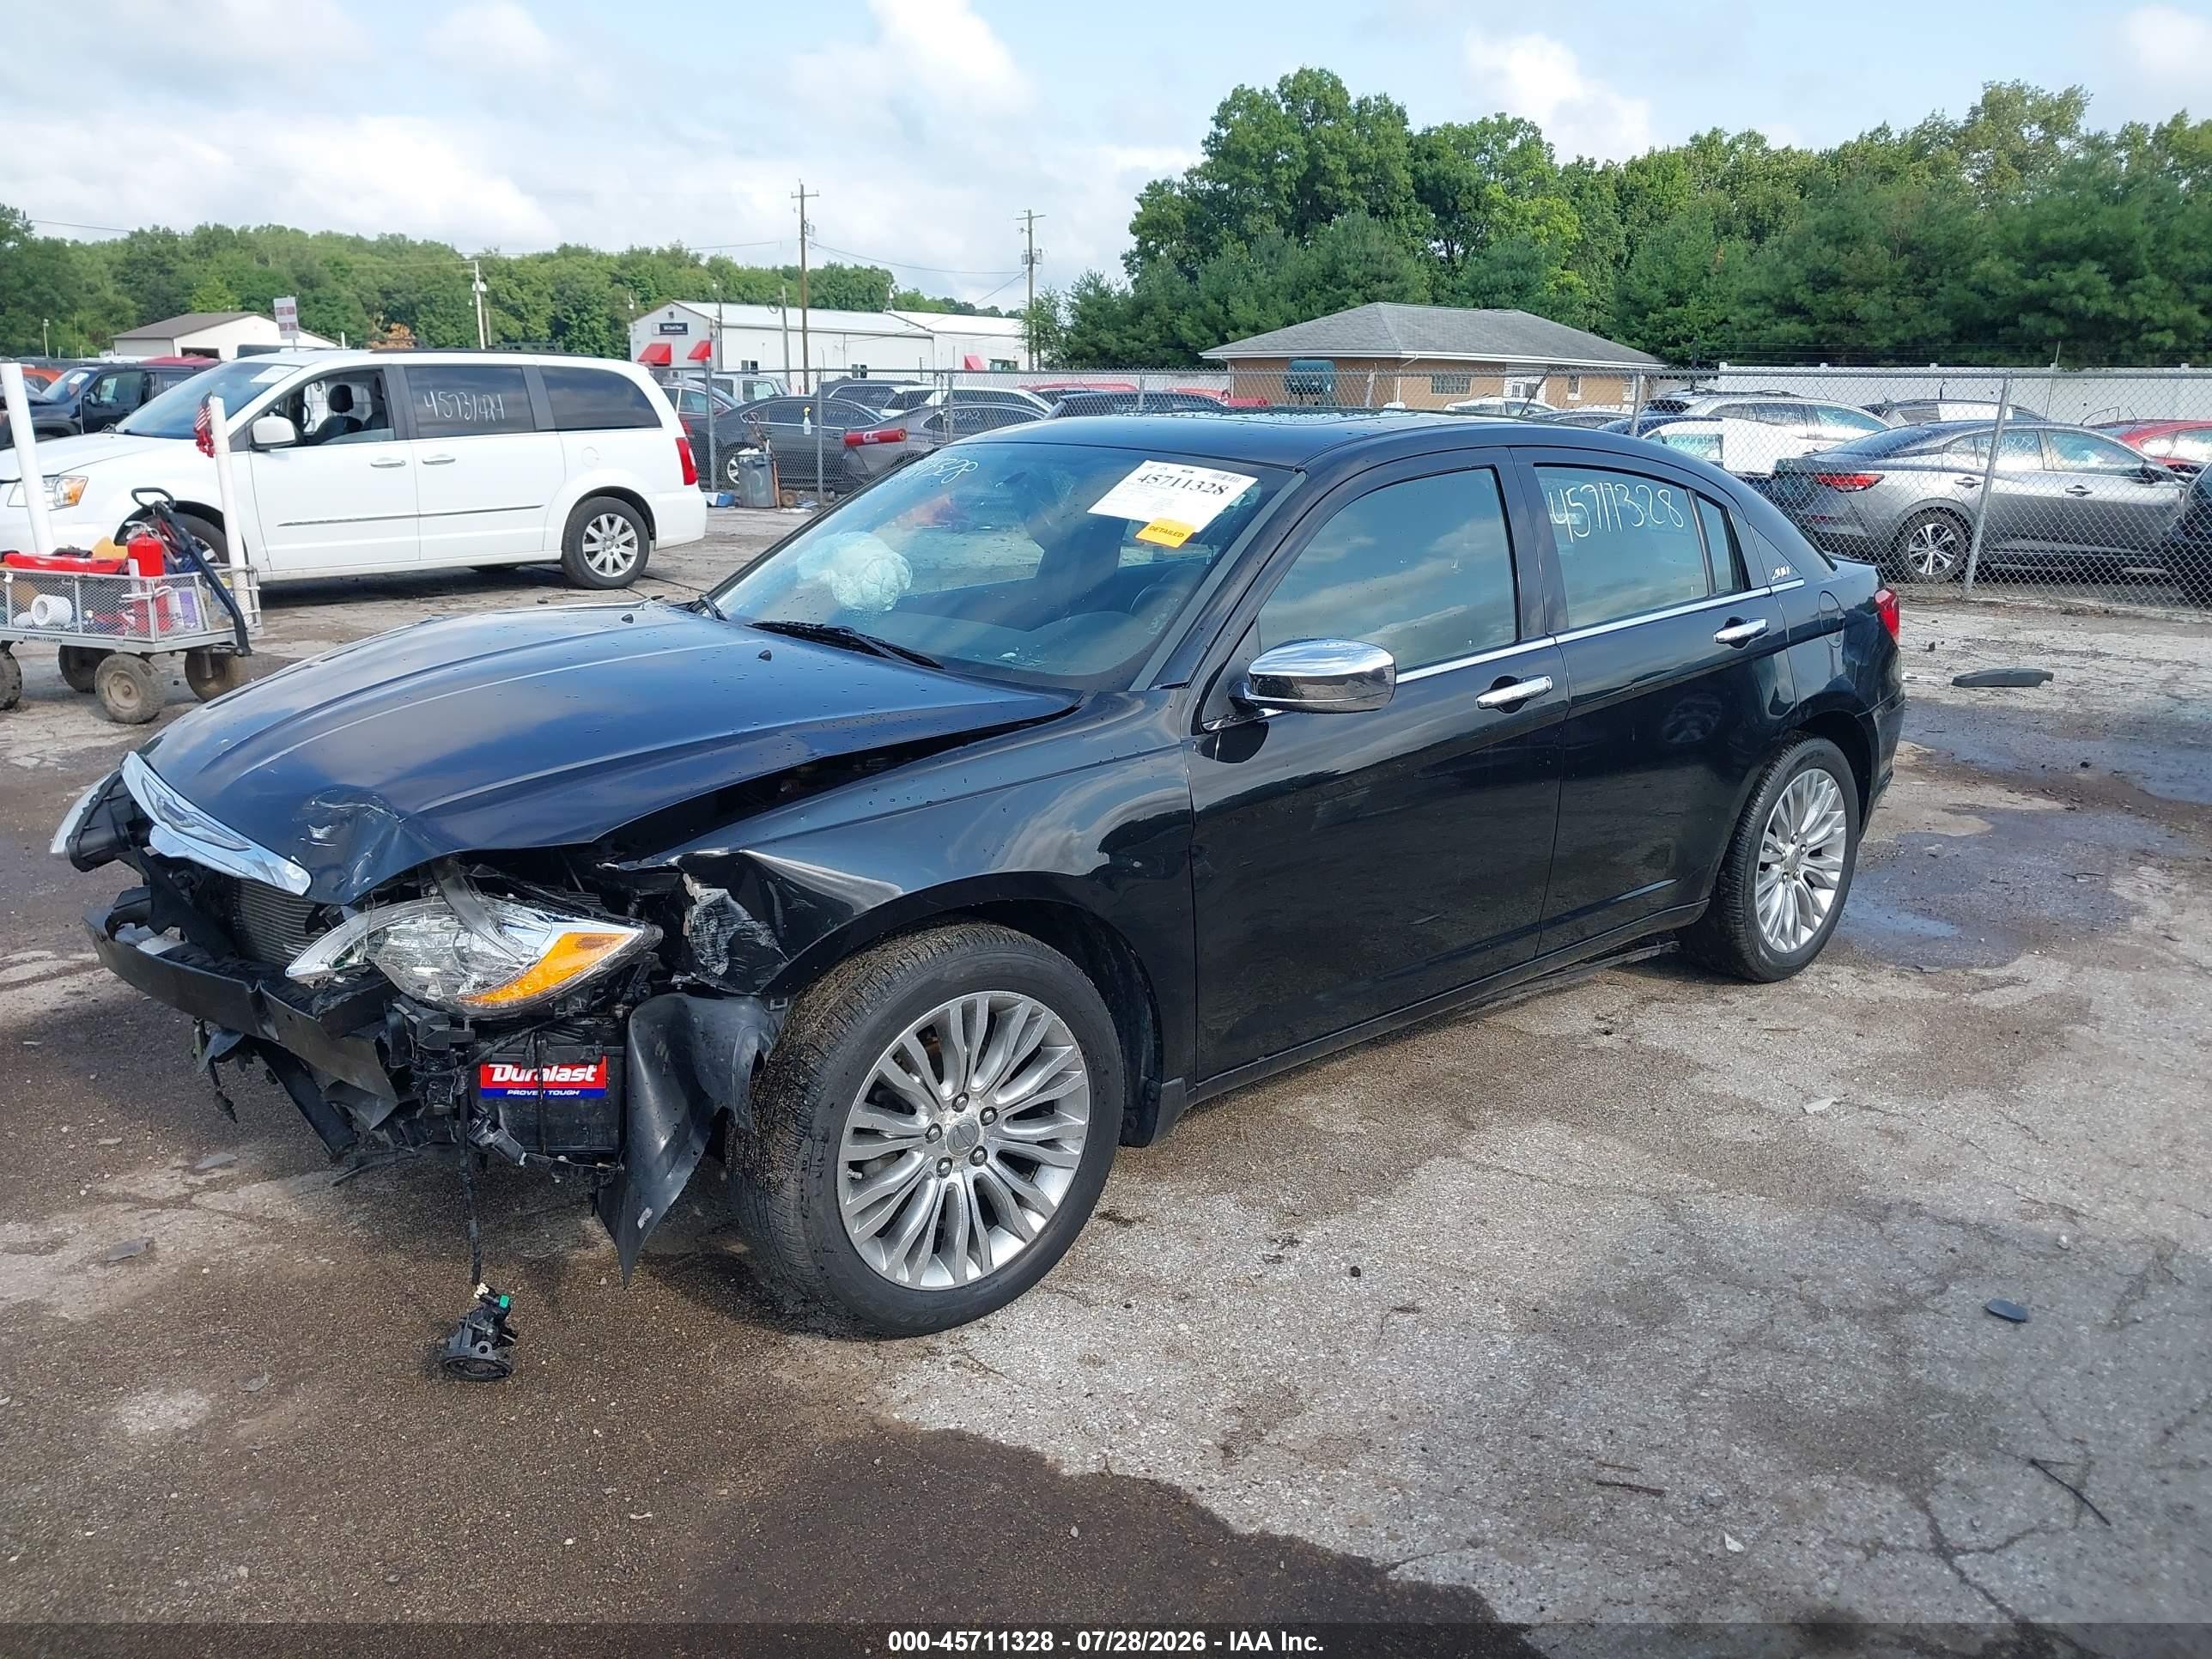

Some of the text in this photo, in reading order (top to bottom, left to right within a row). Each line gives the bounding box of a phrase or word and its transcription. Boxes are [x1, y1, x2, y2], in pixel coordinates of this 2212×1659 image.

[1137, 473, 1230, 495] 45711328
[1548, 482, 1684, 544] 45711328
[1148, 526, 1185, 538] DETAILED
[488, 1064, 597, 1082] Duralast
